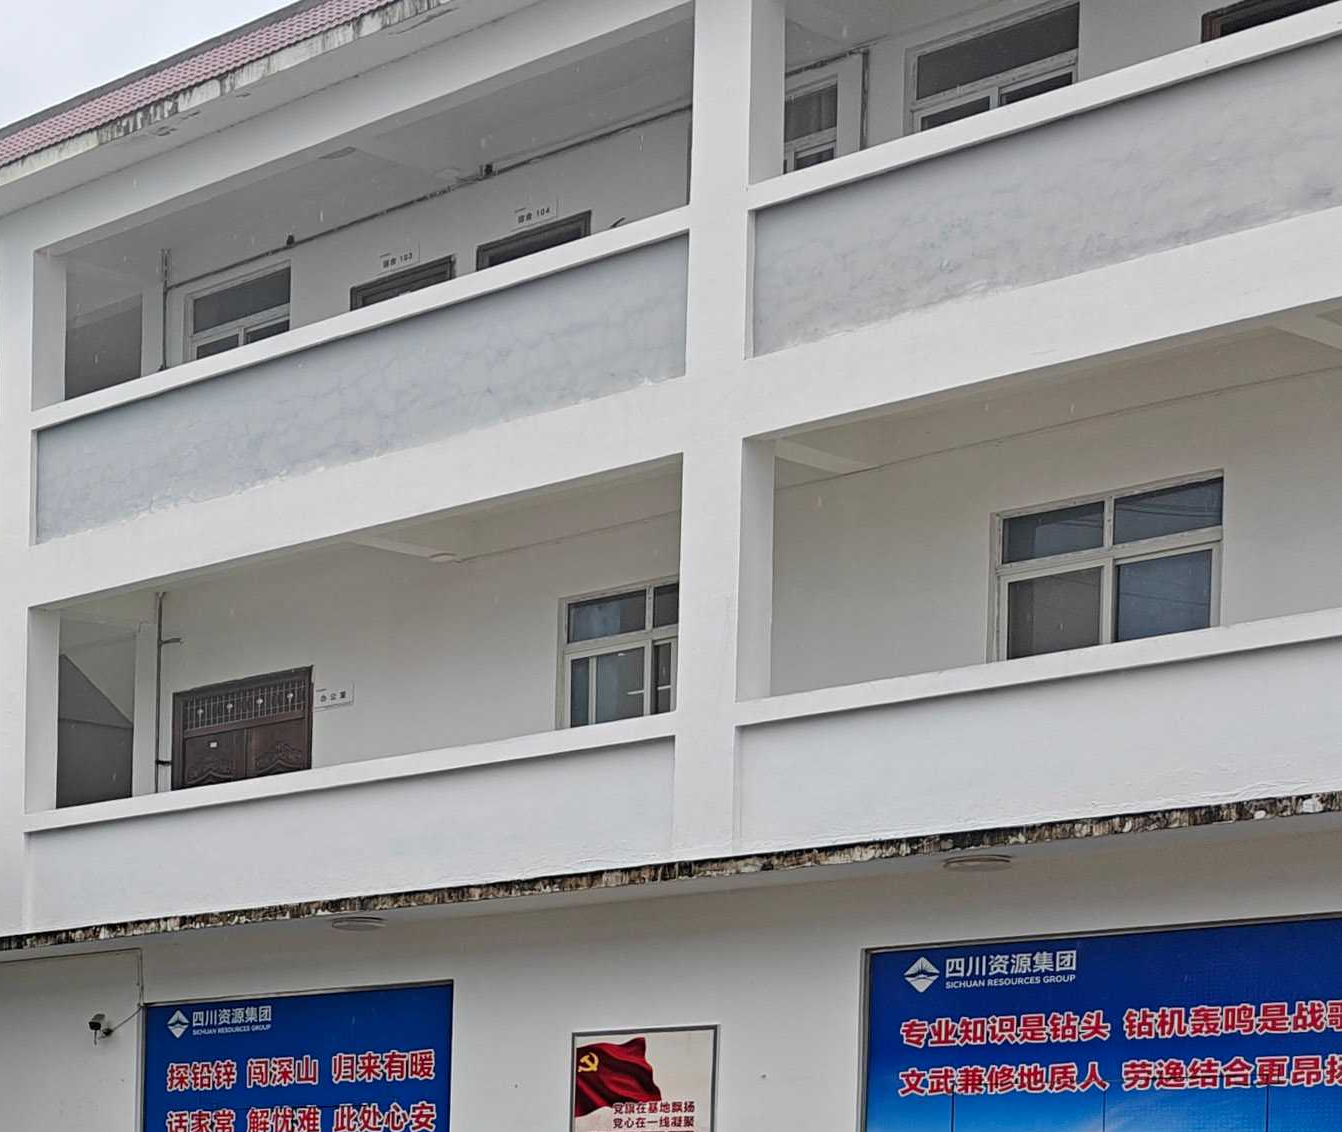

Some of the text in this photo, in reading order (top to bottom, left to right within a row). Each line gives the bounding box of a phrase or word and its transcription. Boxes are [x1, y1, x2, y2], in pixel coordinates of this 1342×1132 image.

[945, 950, 1077, 978] 四川资源集团
[945, 974, 1076, 989] SICHUAN RESOURCES GROUP
[192, 1005, 272, 1027] 四川资源集团
[900, 1010, 1111, 1048] 专业知识是钻头
[166, 1048, 435, 1092] 探铅锌 闯深山 归来有暖
[898, 1061, 1109, 1097] 文武兼修地质人
[613, 1101, 695, 1115] 党旗在基地飘扬
[613, 1116, 695, 1129] 党心在一线凝聚
